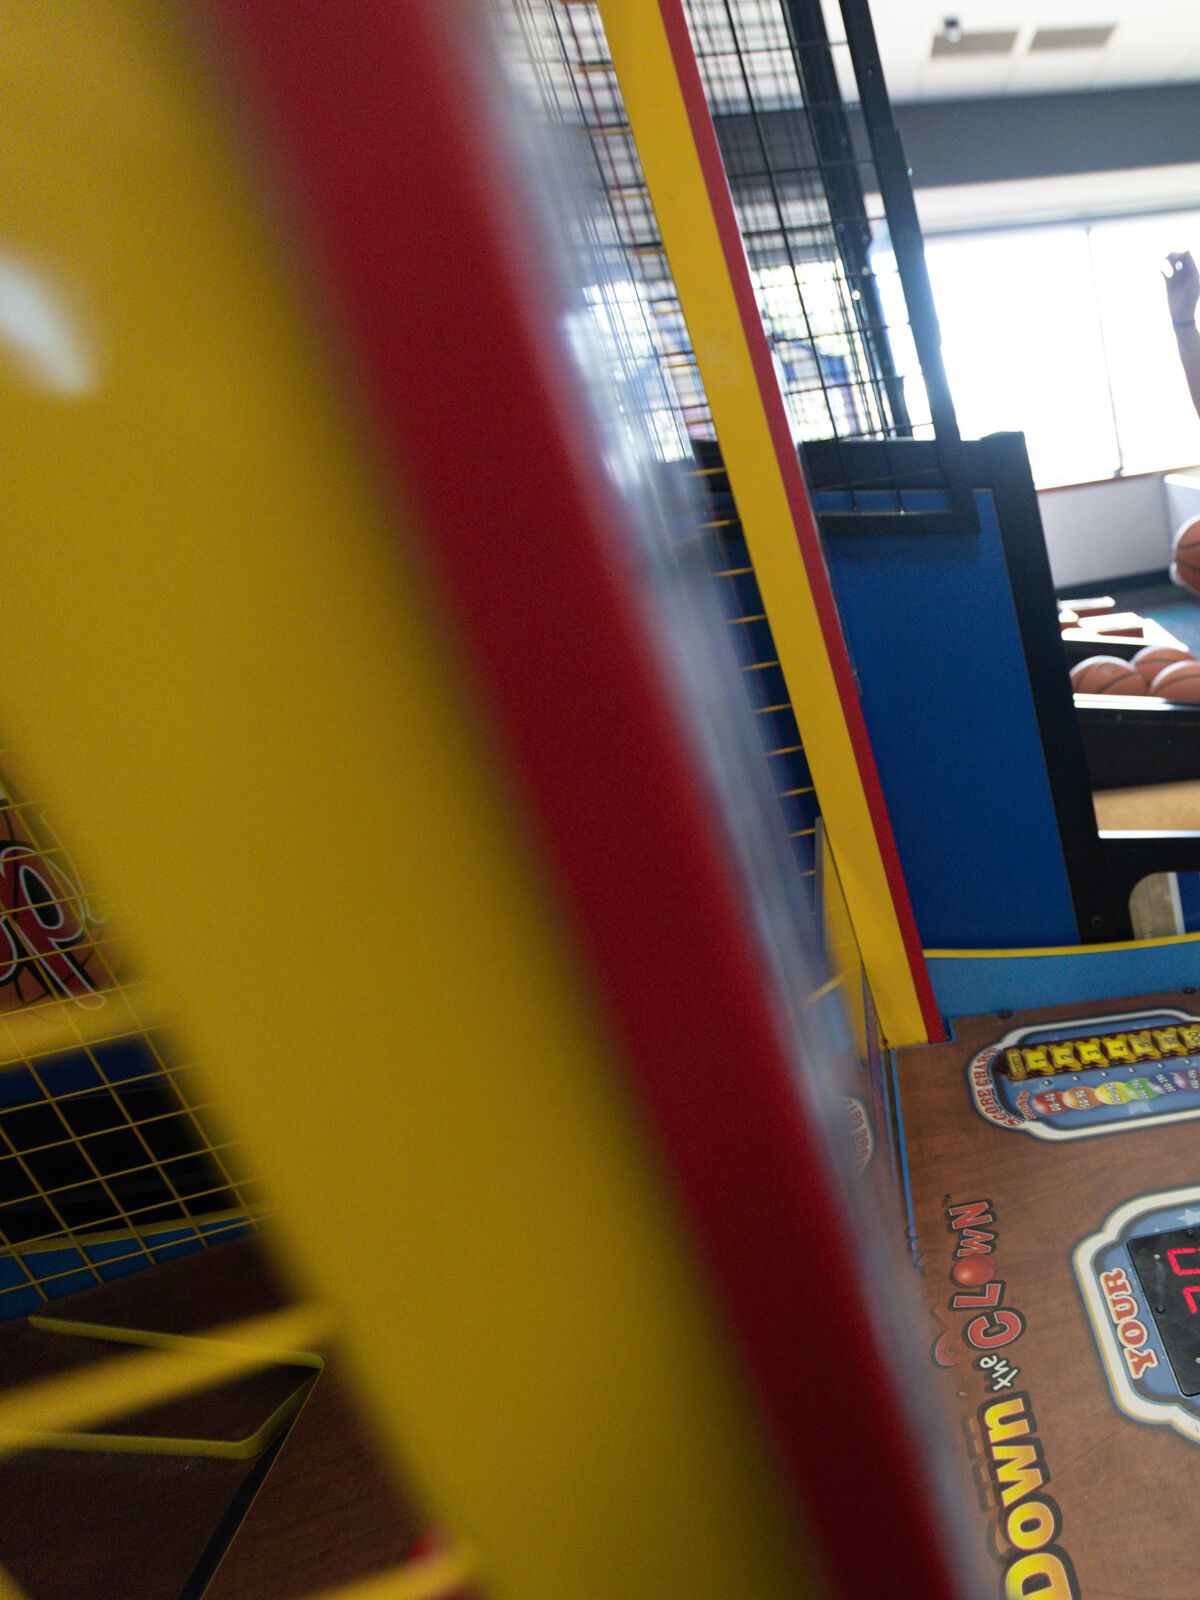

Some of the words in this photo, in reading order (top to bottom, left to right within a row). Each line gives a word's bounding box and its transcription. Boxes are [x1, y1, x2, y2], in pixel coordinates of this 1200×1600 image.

[973, 1048, 998, 1087] CHART
[976, 1089, 1024, 1127] SCORE
[1016, 1090, 1036, 1120] POINTS
[948, 1200, 1023, 1349] CLOWN
[1100, 1268, 1159, 1379] YOUR
[979, 1354, 1019, 1391] the
[983, 1397, 1073, 1600] Down
